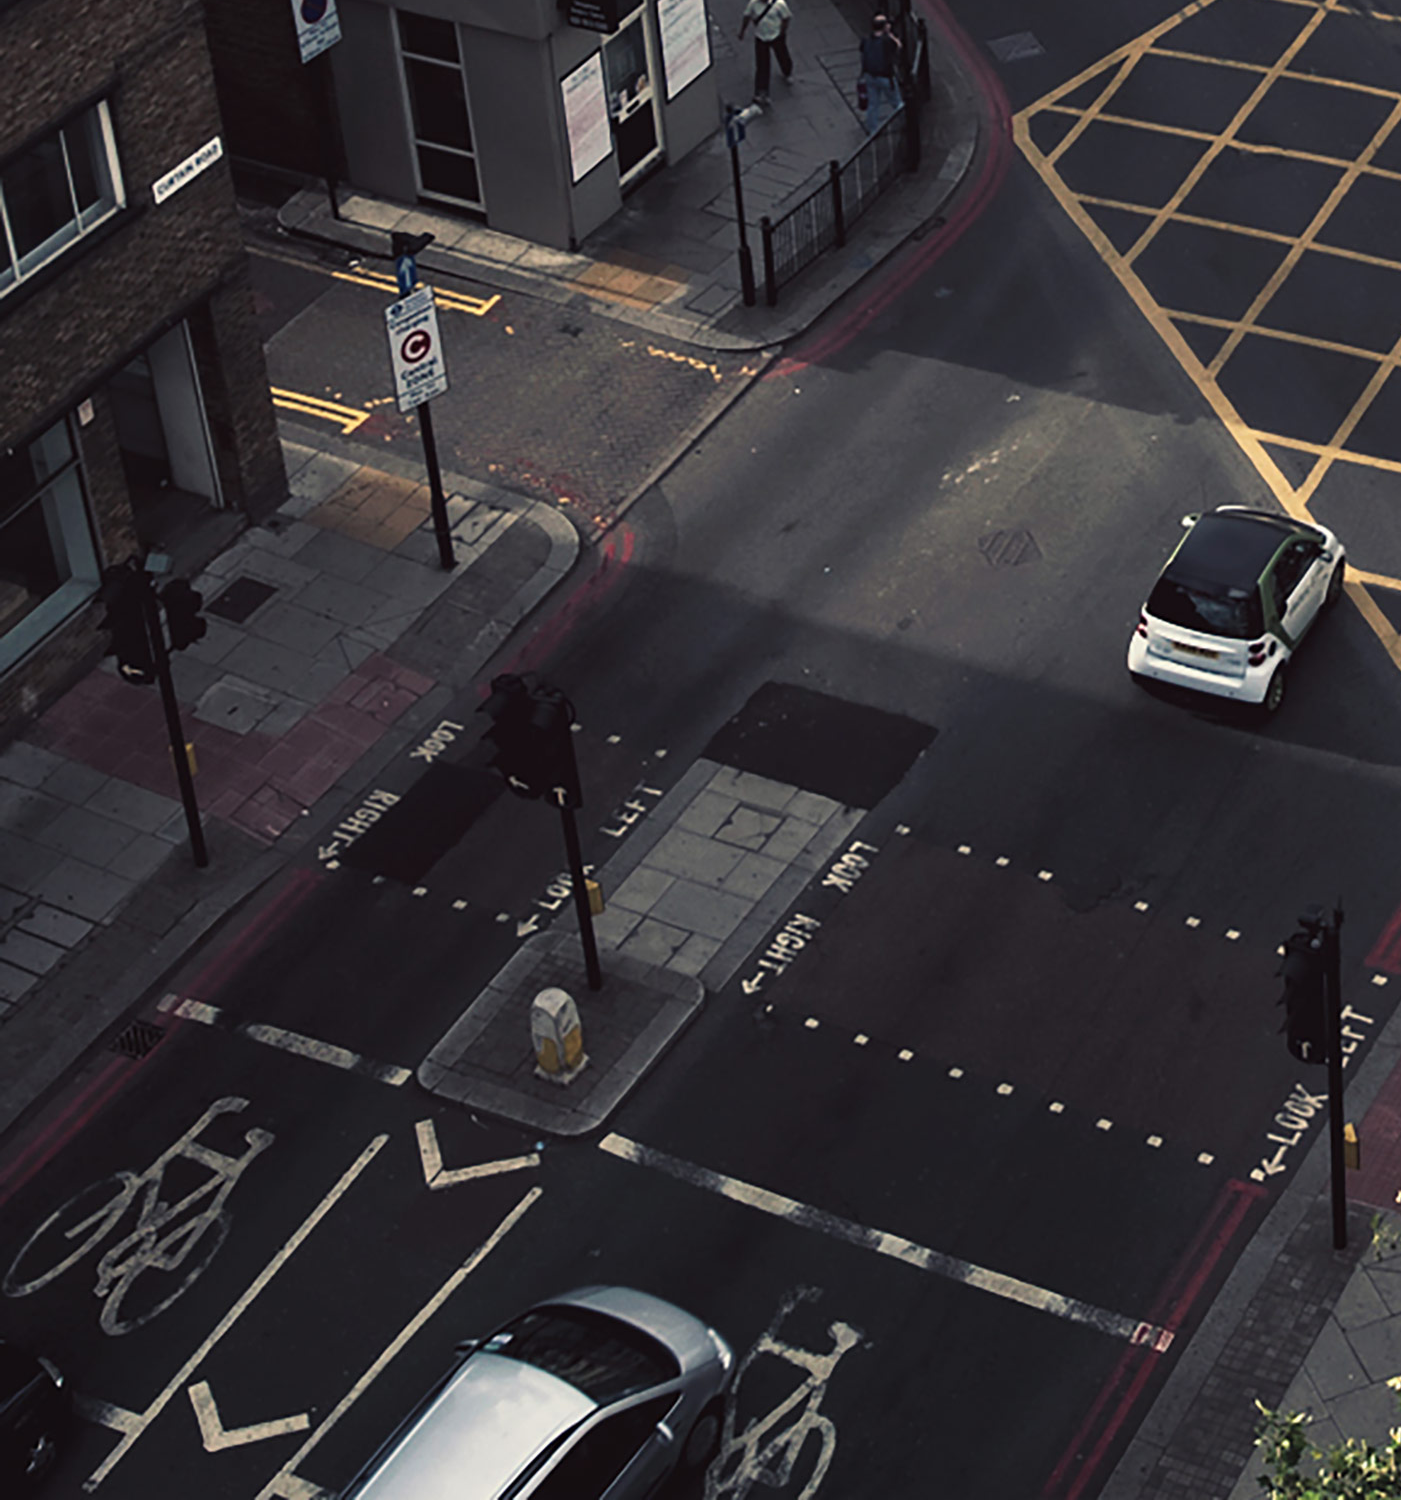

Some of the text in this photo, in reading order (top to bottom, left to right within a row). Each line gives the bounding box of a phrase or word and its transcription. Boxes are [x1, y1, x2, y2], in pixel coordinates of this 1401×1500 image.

[331, 719, 465, 847] LOOK RIGHT
[600, 779, 664, 848] LEFT
[758, 840, 880, 977] LOOK RIGHT
[1266, 1083, 1330, 1147] LOOK
